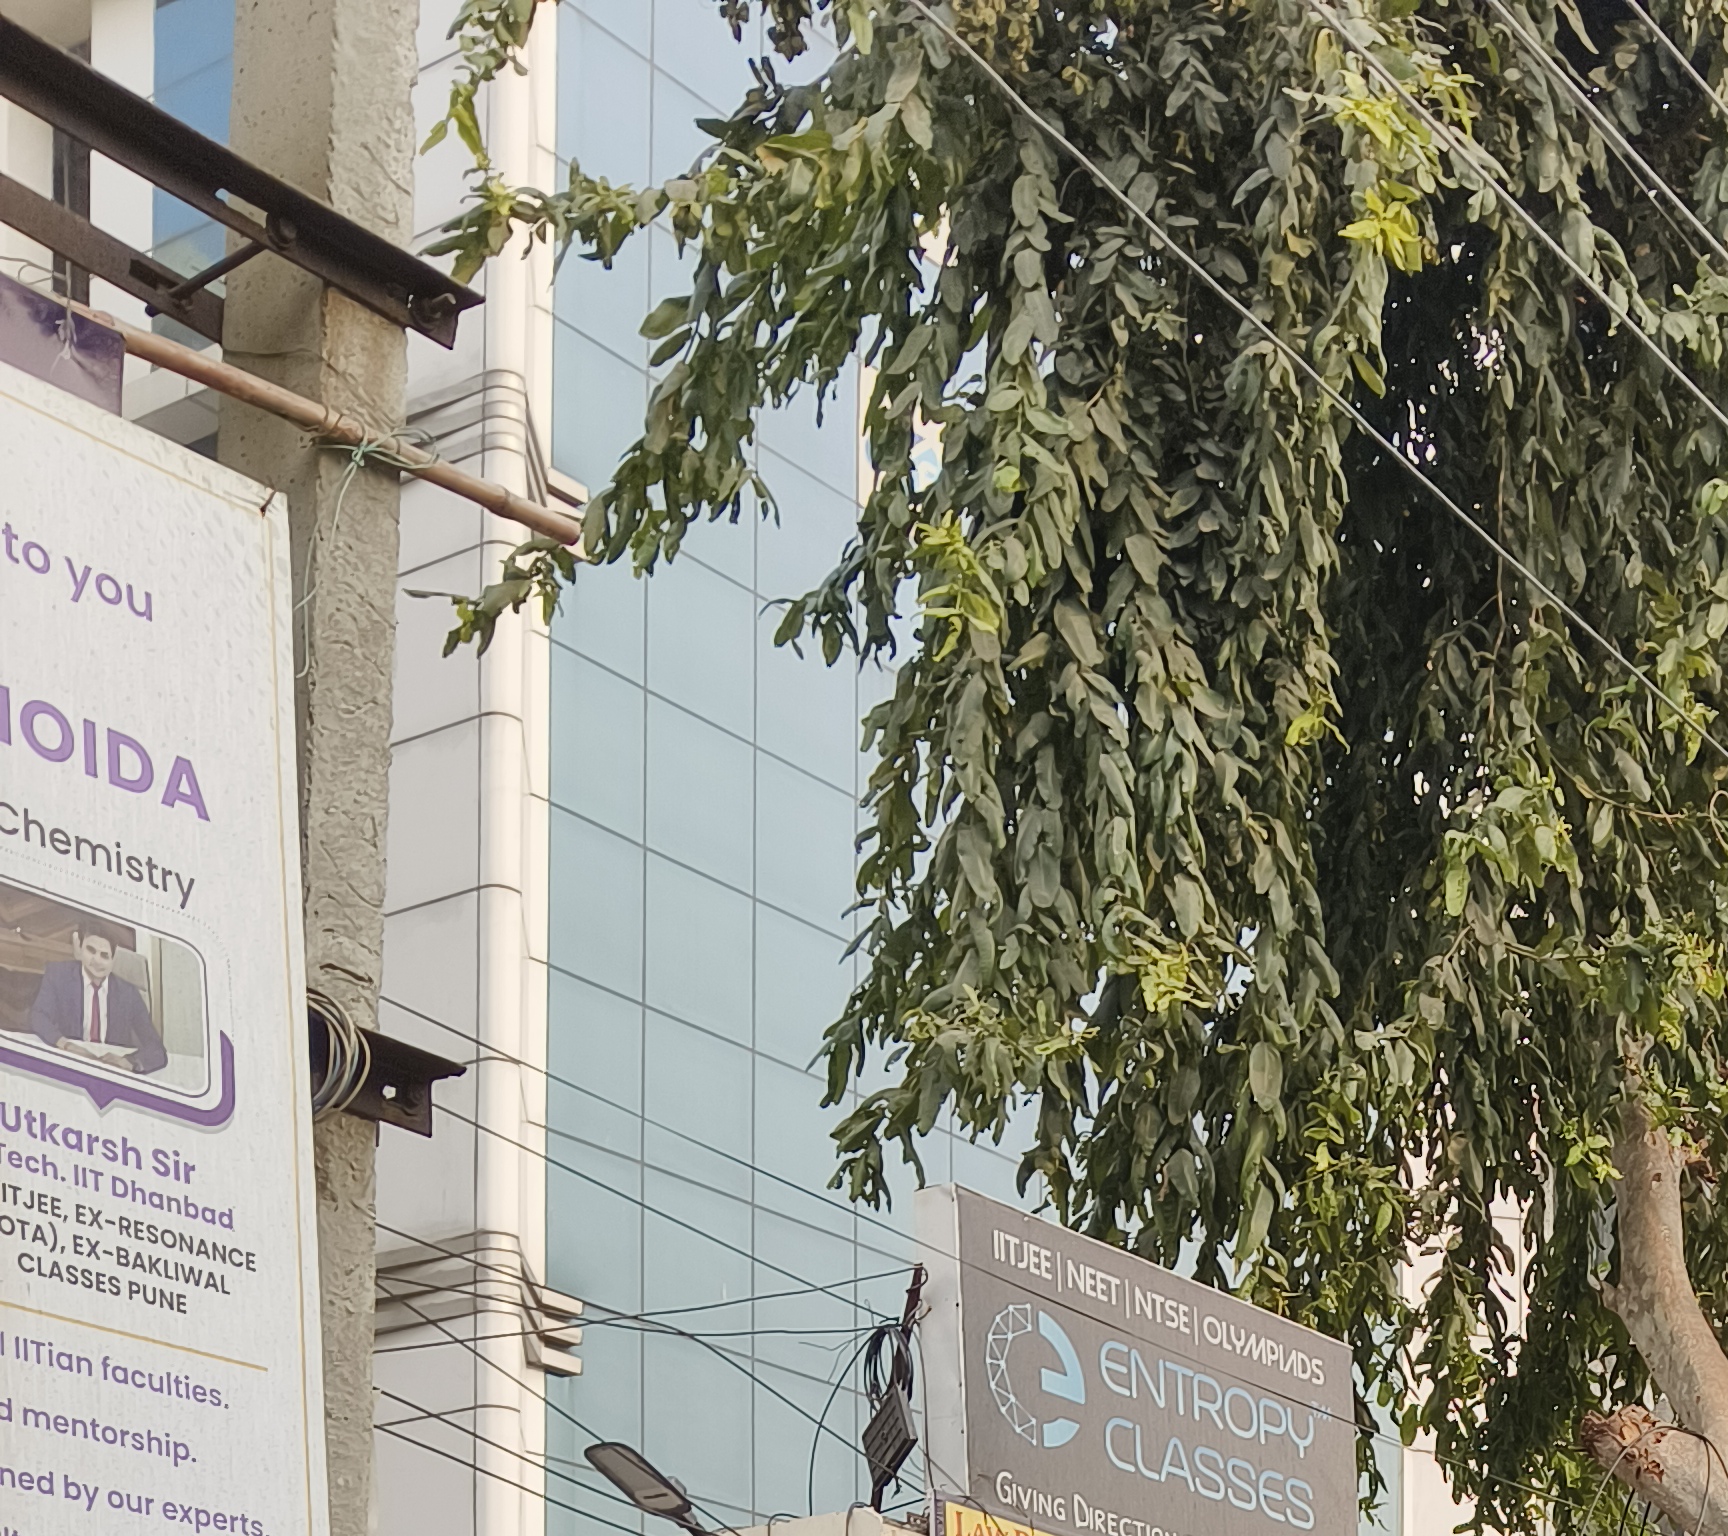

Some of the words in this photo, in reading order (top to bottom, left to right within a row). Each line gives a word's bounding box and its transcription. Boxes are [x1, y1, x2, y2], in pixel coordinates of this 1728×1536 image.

[2, 521, 50, 575] to
[64, 556, 152, 622] you
[1, 1102, 142, 1171] Utkarsh
[152, 1149, 196, 1184] Sir
[74, 1164, 104, 1192] IIT
[111, 1175, 234, 1230] Dhanbad
[73, 1234, 231, 1295] EX-BAKLIWAL
[75, 1203, 257, 1272] EX-RESONANCE
[18, 1253, 121, 1296] CLASSES
[128, 1280, 187, 1315] PUNE
[993, 1230, 1053, 1281] IITJEE
[1067, 1259, 1121, 1306] NEET
[1135, 1290, 1191, 1335] NTSE
[1203, 1316, 1325, 1386] OLYMPIADS
[14, 1336, 92, 1376] IITian
[101, 1356, 229, 1409] faculties.
[1100, 1340, 1315, 1459] ENTROPY
[22, 1406, 197, 1467] mentorship.
[63, 1474, 99, 1512] by
[107, 1490, 154, 1516] our
[996, 1471, 1066, 1520] GIVING
[1105, 1416, 1315, 1531] CLASSES
